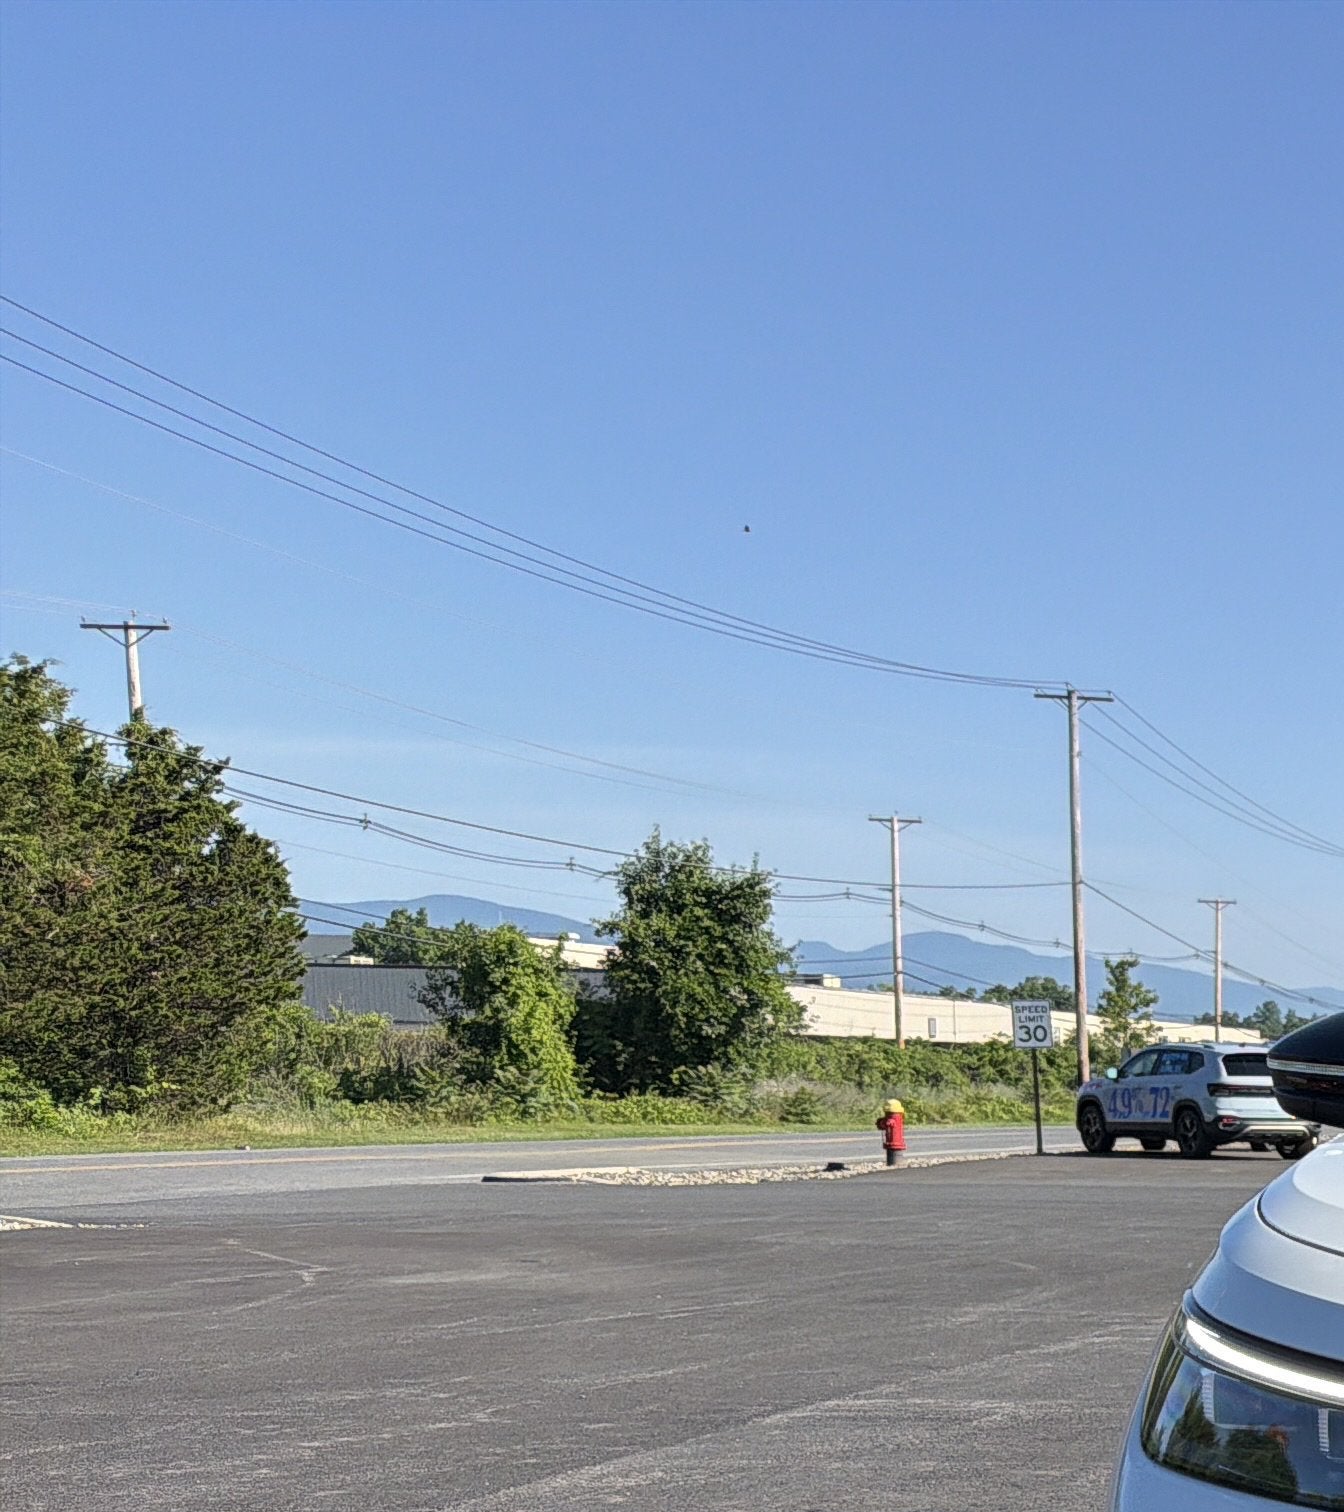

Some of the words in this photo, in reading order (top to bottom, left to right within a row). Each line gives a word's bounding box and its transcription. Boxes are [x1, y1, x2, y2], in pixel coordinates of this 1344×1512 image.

[1014, 1005, 1048, 1014] SPEED
[1019, 1015, 1045, 1024] LIMIT
[1018, 1025, 1048, 1043] 30
